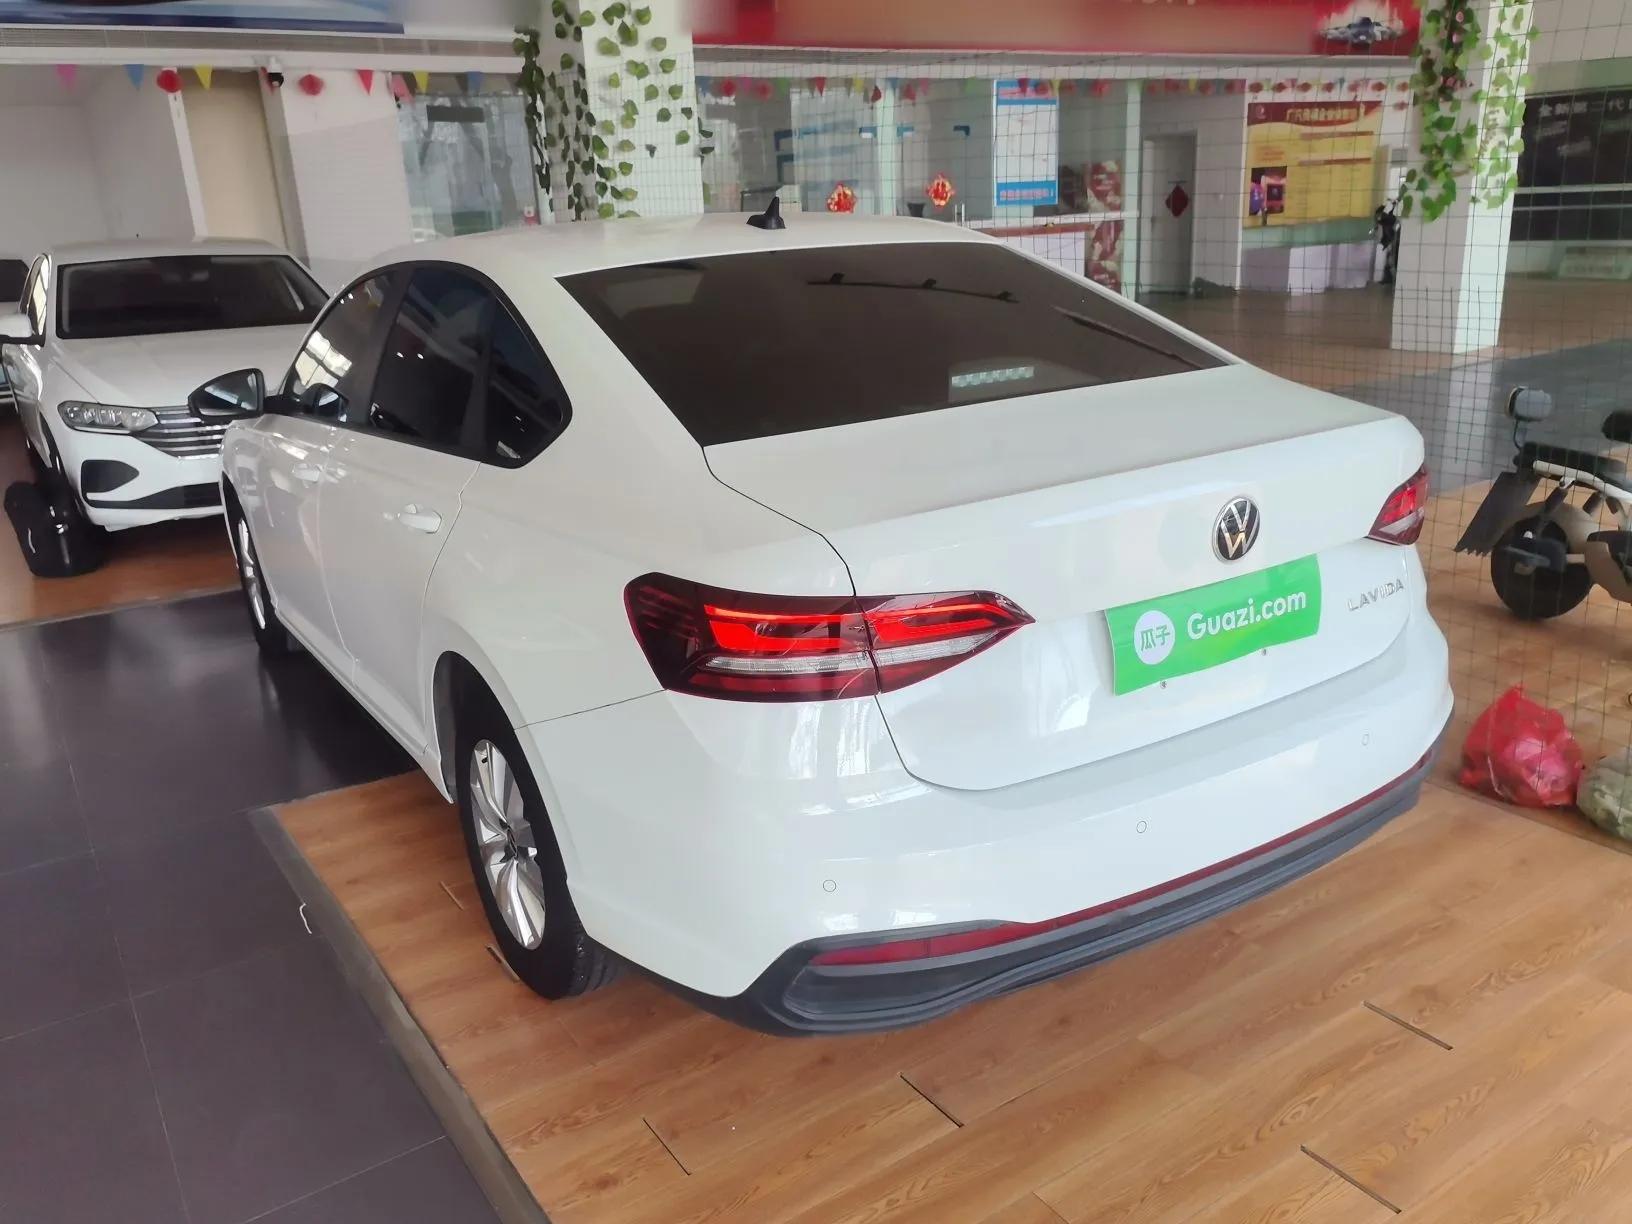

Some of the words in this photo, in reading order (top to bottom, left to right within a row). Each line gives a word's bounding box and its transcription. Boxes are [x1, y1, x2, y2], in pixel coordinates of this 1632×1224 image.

[1348, 579, 1404, 612] LAVIDA
[1187, 592, 1306, 640] Guazi.com
[1140, 625, 1170, 651] 瓜子
